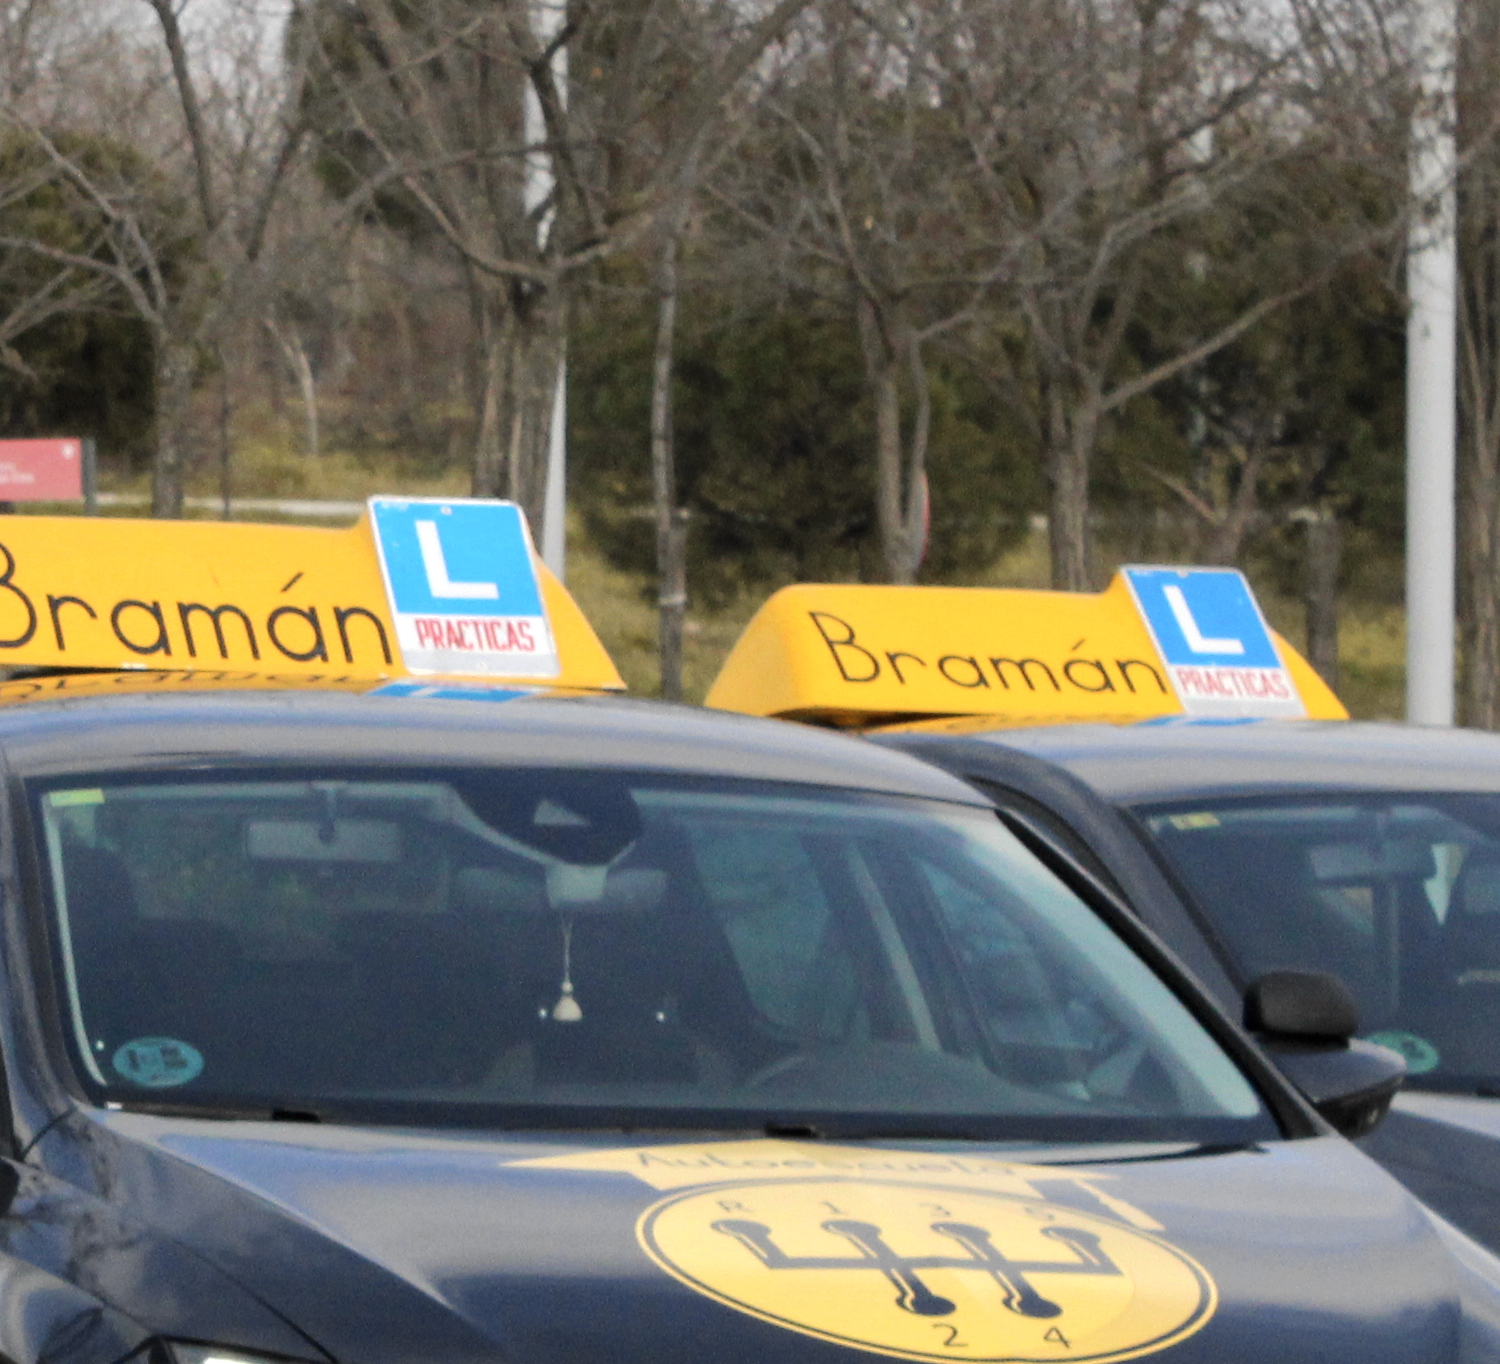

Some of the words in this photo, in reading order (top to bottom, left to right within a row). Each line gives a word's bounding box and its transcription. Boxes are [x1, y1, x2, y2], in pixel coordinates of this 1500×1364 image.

[414, 520, 499, 599] L
[415, 618, 535, 651] PRACTICAS
[1162, 585, 1245, 654] L
[807, 611, 1168, 694] Bramán
[1175, 669, 1290, 699] PRACTICAS
[932, 1323, 969, 1347] 2
[1043, 1326, 1071, 1349] 4
